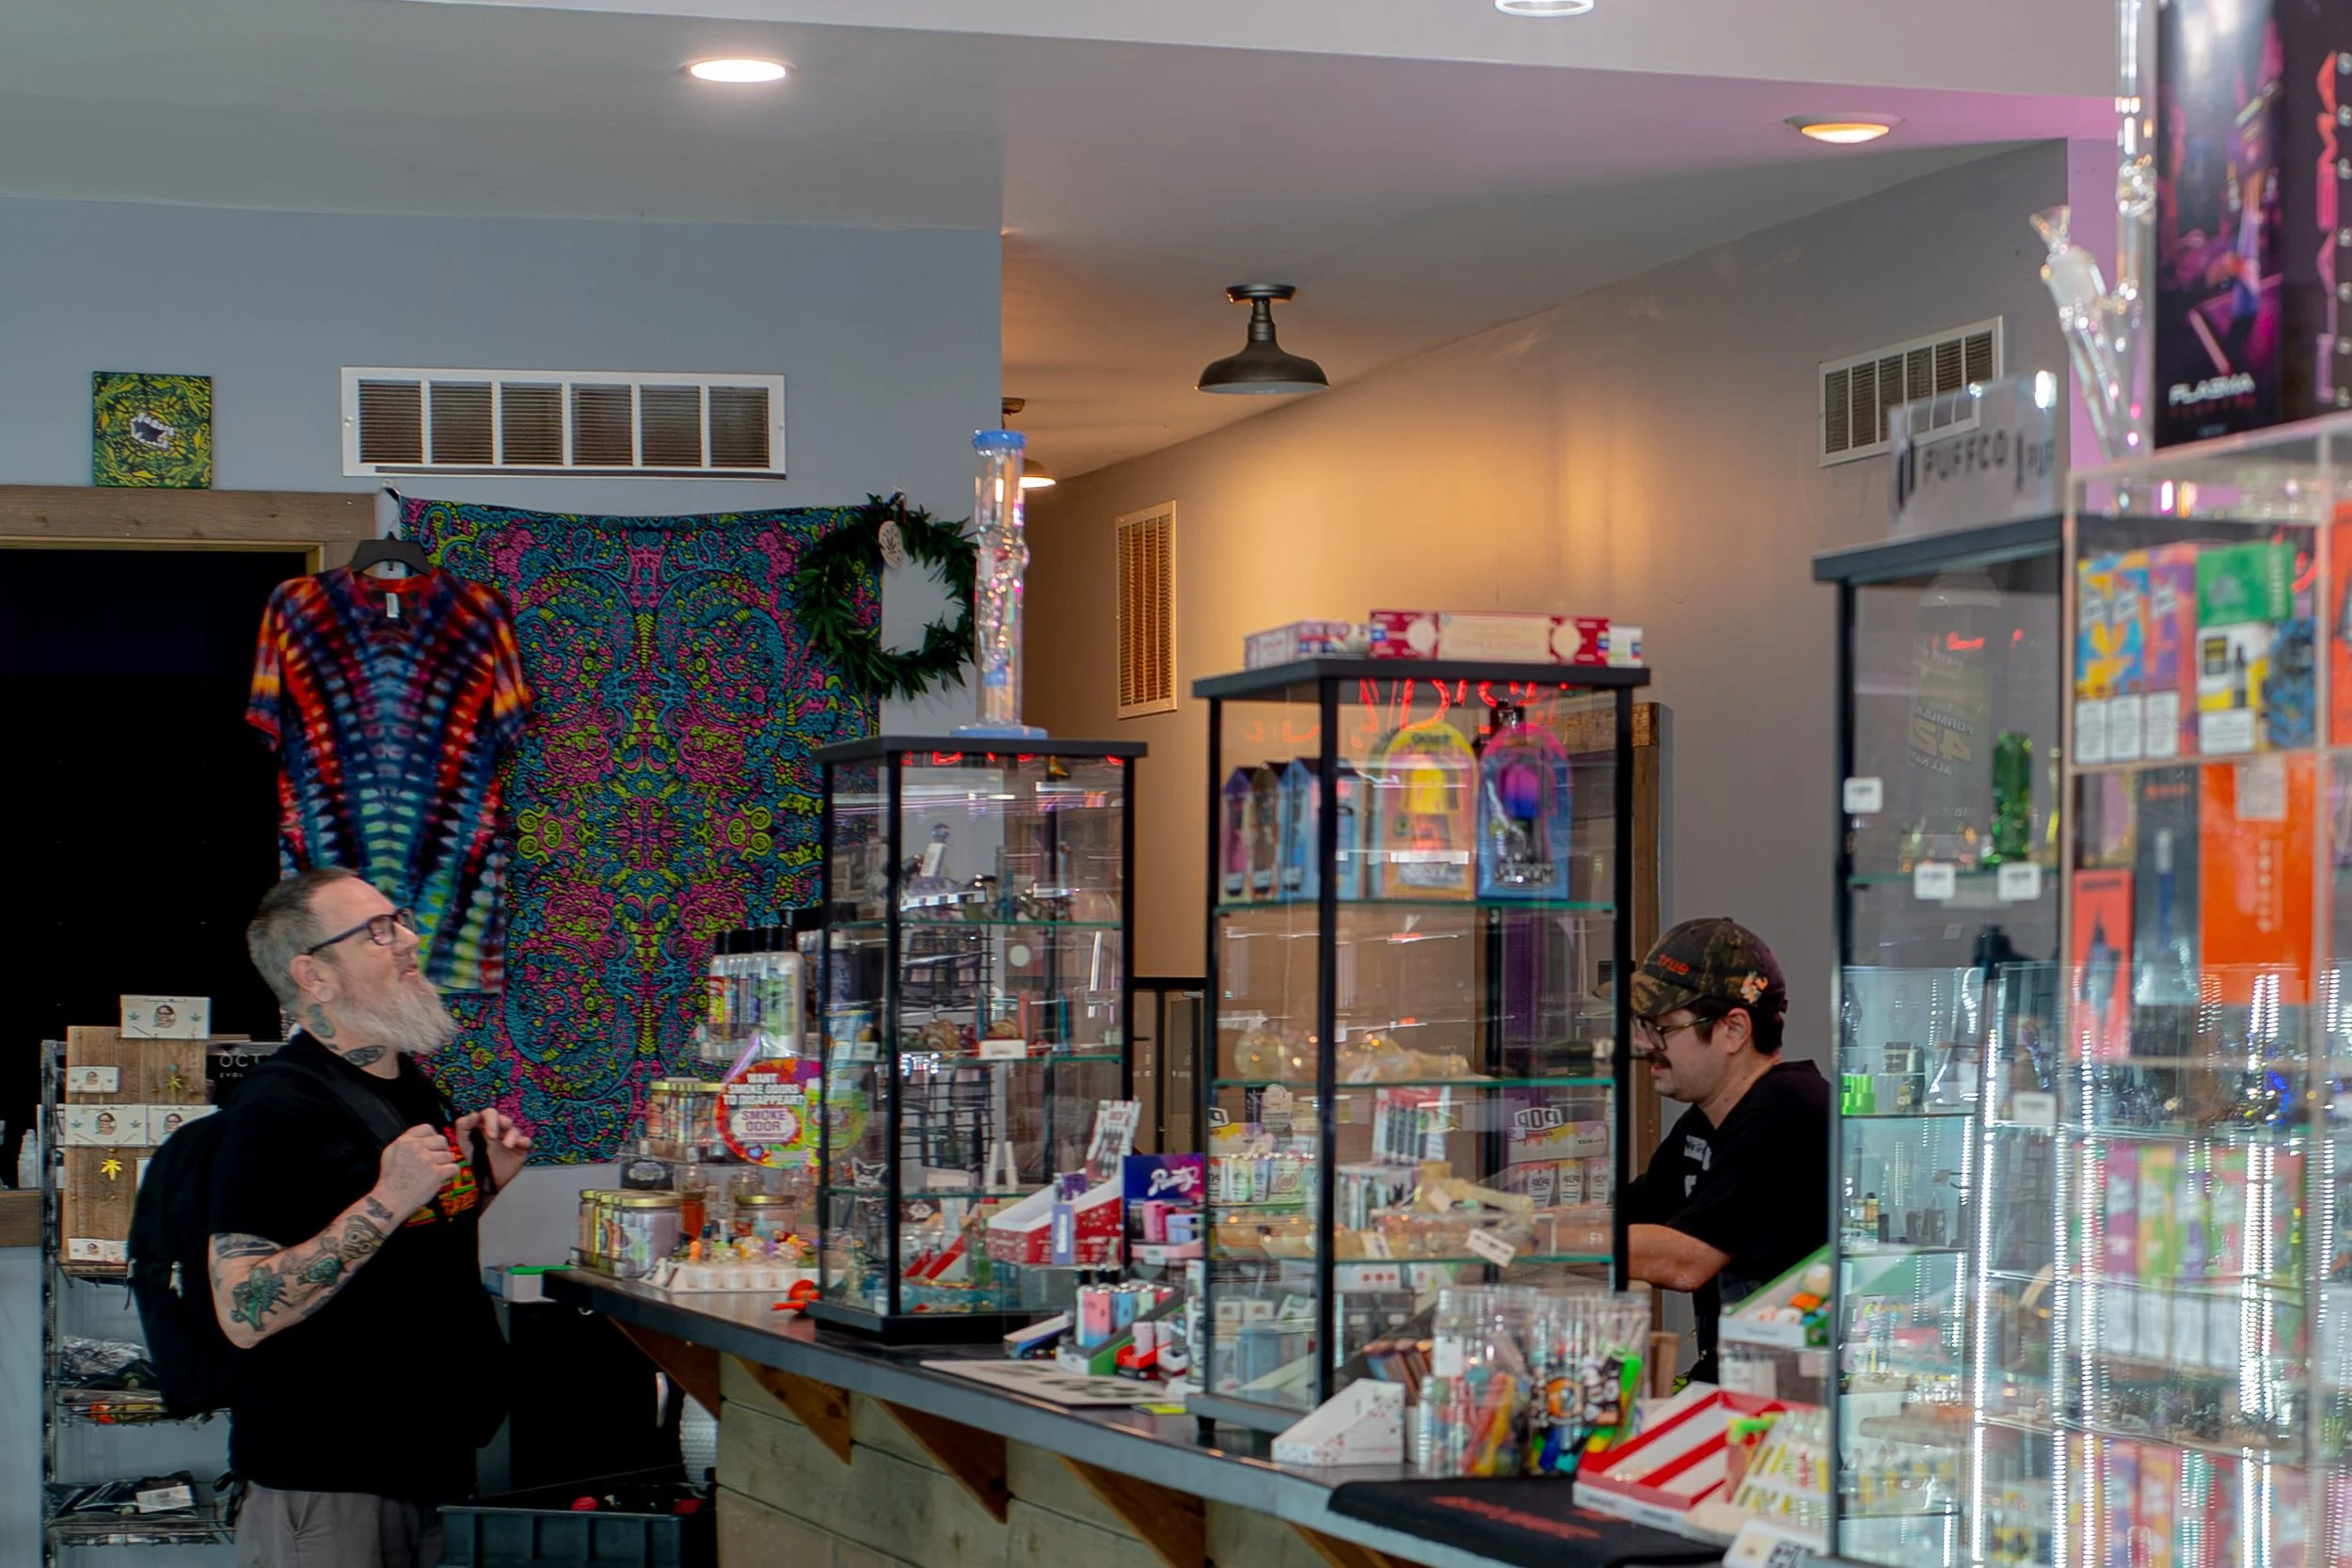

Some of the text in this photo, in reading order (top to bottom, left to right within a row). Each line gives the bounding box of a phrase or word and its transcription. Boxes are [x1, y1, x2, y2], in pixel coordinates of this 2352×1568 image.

[2169, 372, 2256, 406] PLASMA
[1923, 429, 2010, 484] PUFFCO
[746, 1073, 779, 1084] WANT
[727, 1084, 764, 1094] SMOKE
[723, 1095, 738, 1105] TO
[741, 1110, 786, 1120] SMOKE
[745, 1121, 782, 1132] ODOR
